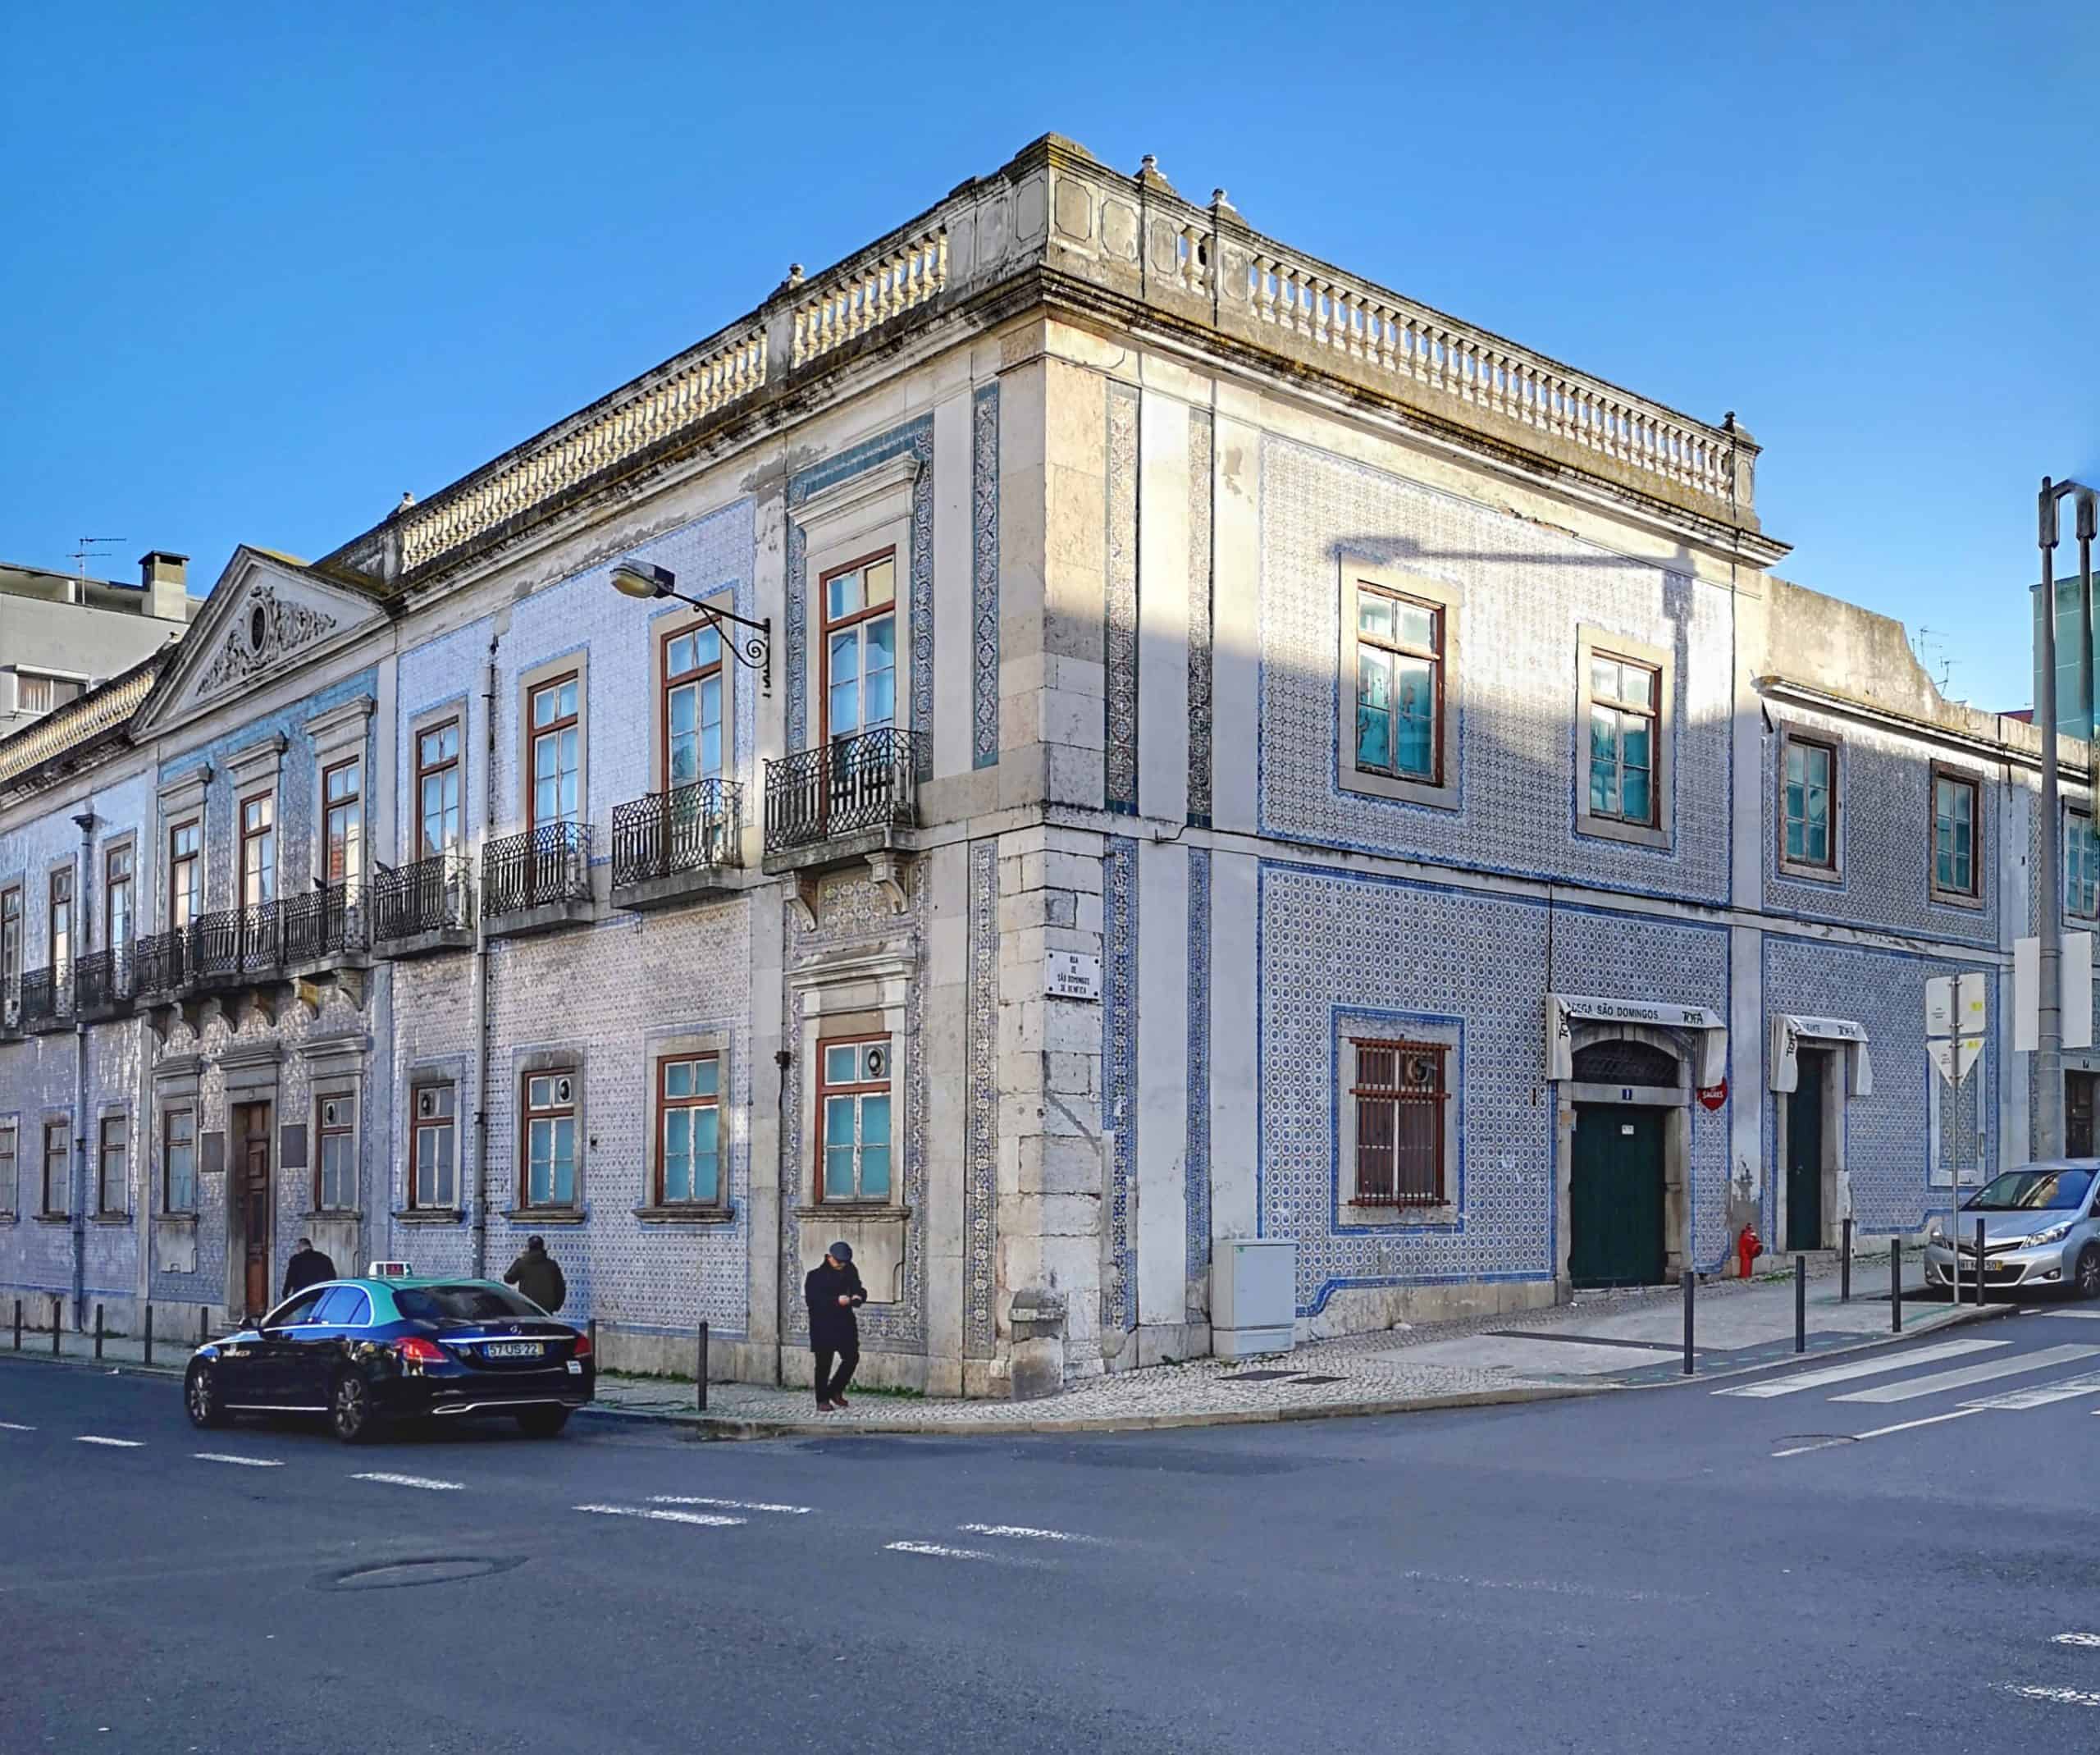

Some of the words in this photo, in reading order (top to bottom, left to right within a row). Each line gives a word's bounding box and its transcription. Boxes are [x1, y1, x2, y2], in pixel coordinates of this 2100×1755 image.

[1057, 971, 1066, 983] SÃO
[1067, 975, 1089, 986] DOMINGOS
[1596, 1003, 1614, 1017] SÃO
[1617, 1007, 1659, 1020] DOMINGOS
[1702, 1090, 1724, 1099] SAGRES
